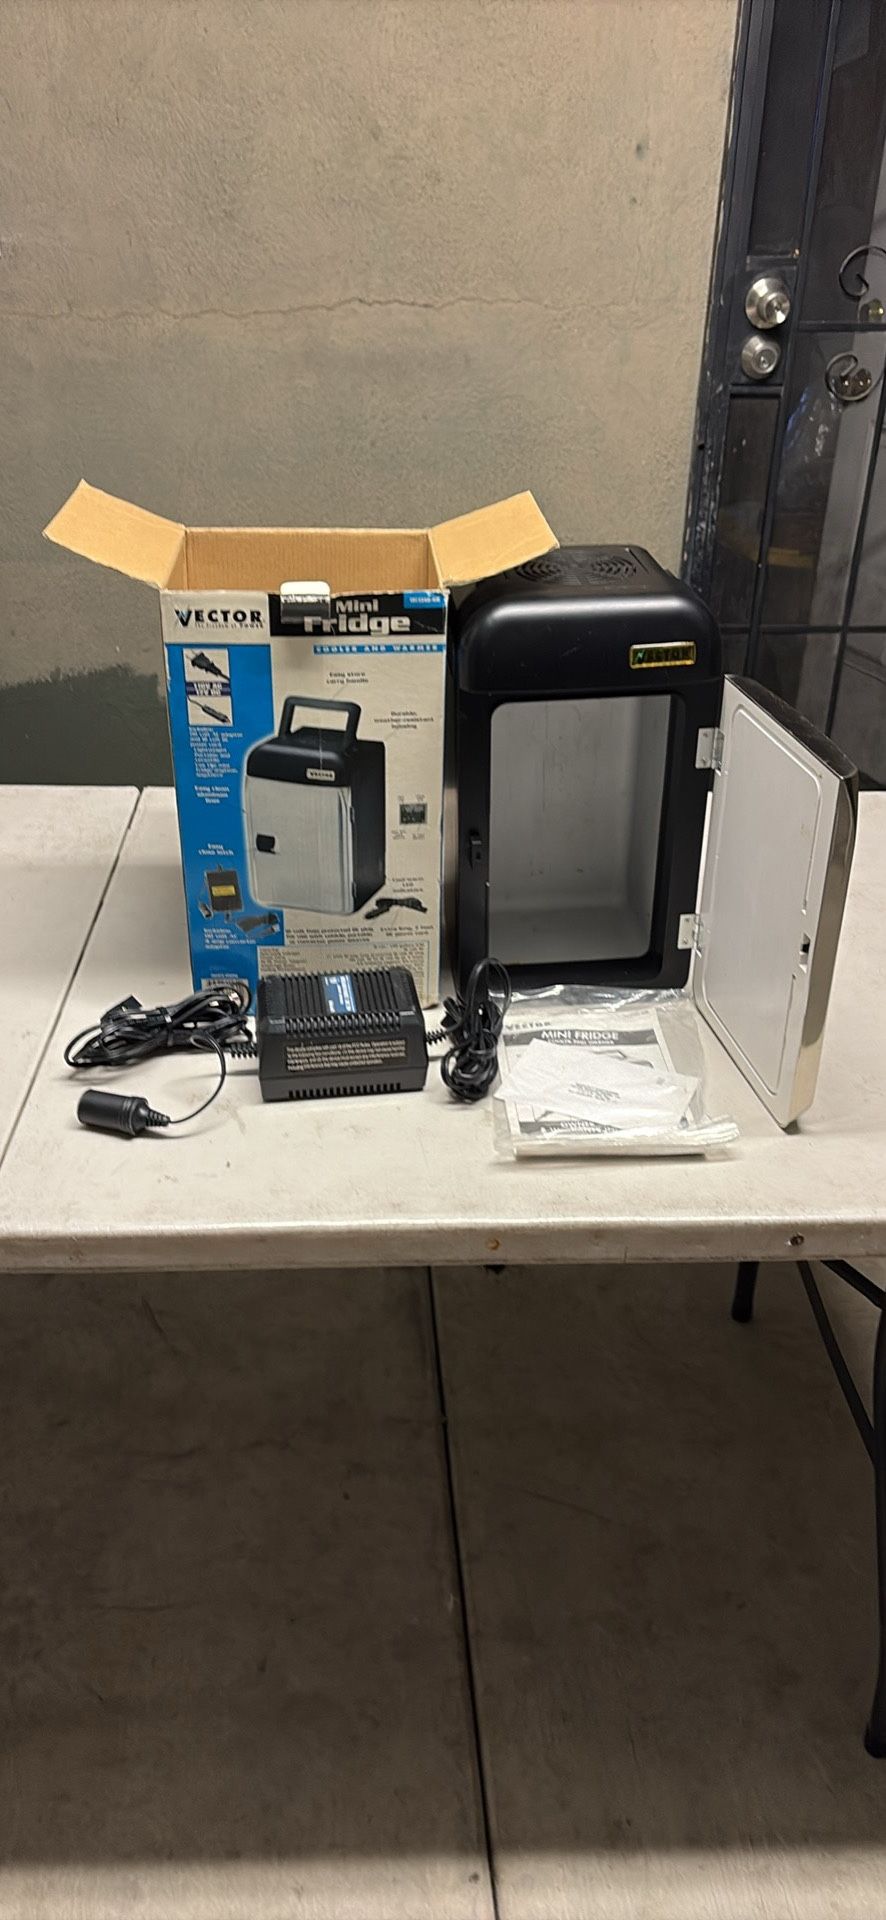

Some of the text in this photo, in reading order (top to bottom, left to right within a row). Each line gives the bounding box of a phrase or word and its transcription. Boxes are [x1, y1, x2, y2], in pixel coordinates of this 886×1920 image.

[335, 599, 379, 613] Mini
[174, 609, 263, 627] VECTOR
[303, 613, 411, 636] Fridge
[541, 1030, 619, 1041] MINI FRIDGE
